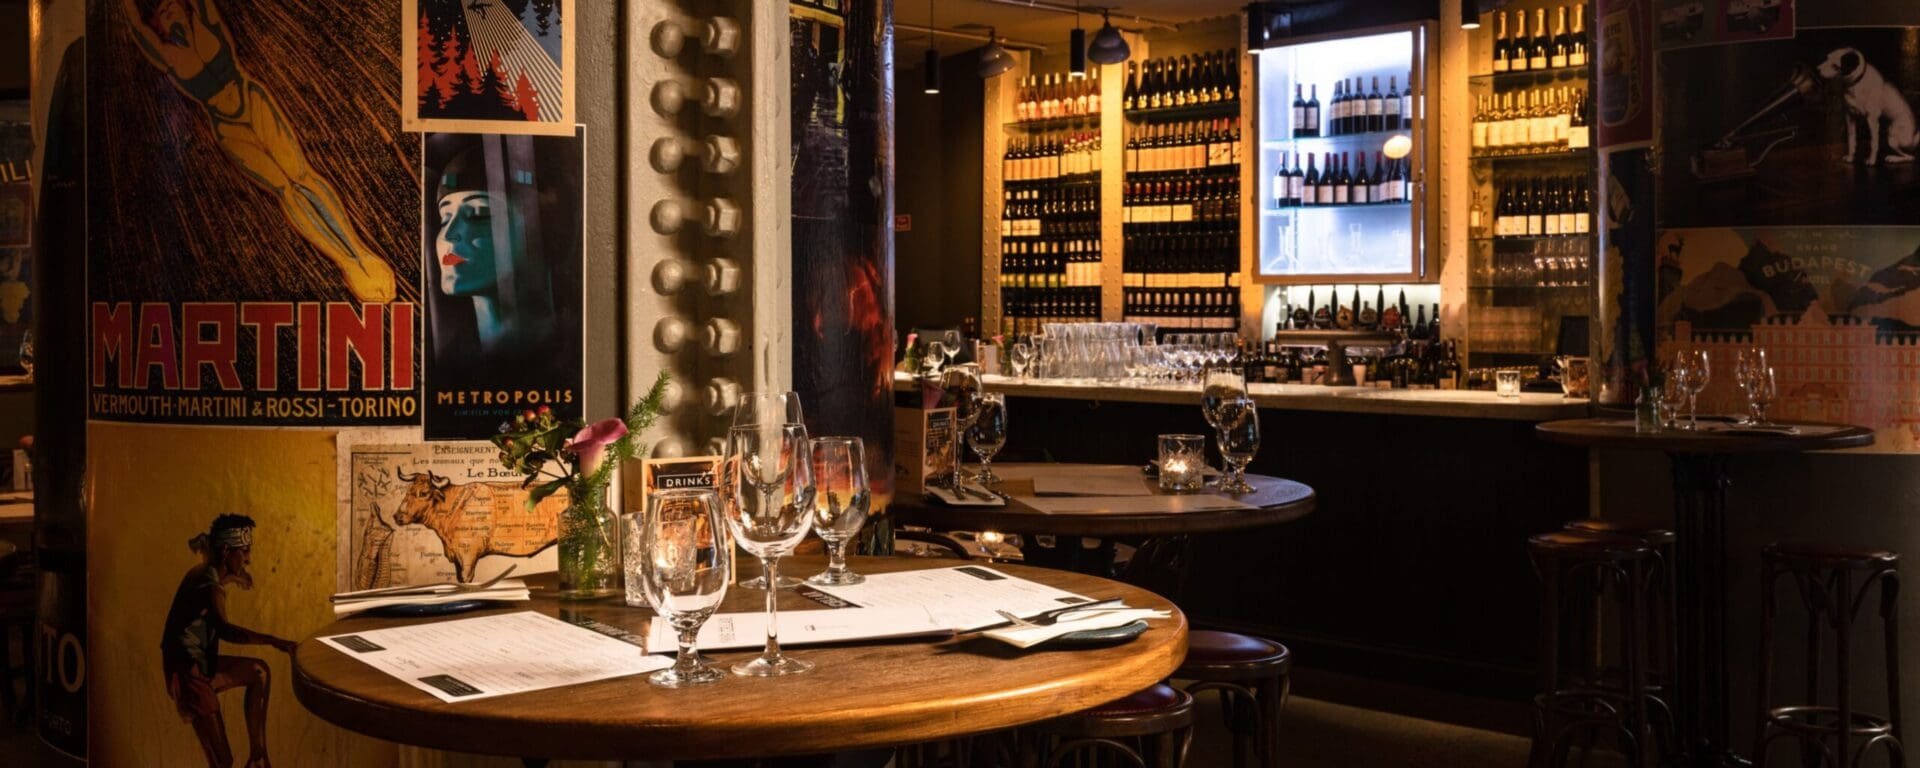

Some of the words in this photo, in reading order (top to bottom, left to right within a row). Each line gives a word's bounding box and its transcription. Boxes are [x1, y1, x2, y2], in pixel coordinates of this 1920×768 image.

[1761, 255, 1873, 282] BUDAPEST
[92, 301, 415, 391] MARTINI
[436, 389, 573, 405] METROPOLIS
[266, 396, 324, 418] ROSSI
[338, 396, 417, 418] TORINO
[469, 458, 485, 467] que
[466, 467, 485, 478] Le
[487, 467, 522, 478] Bœu
[665, 476, 711, 488] DRINKS
[39, 622, 86, 694] TO
